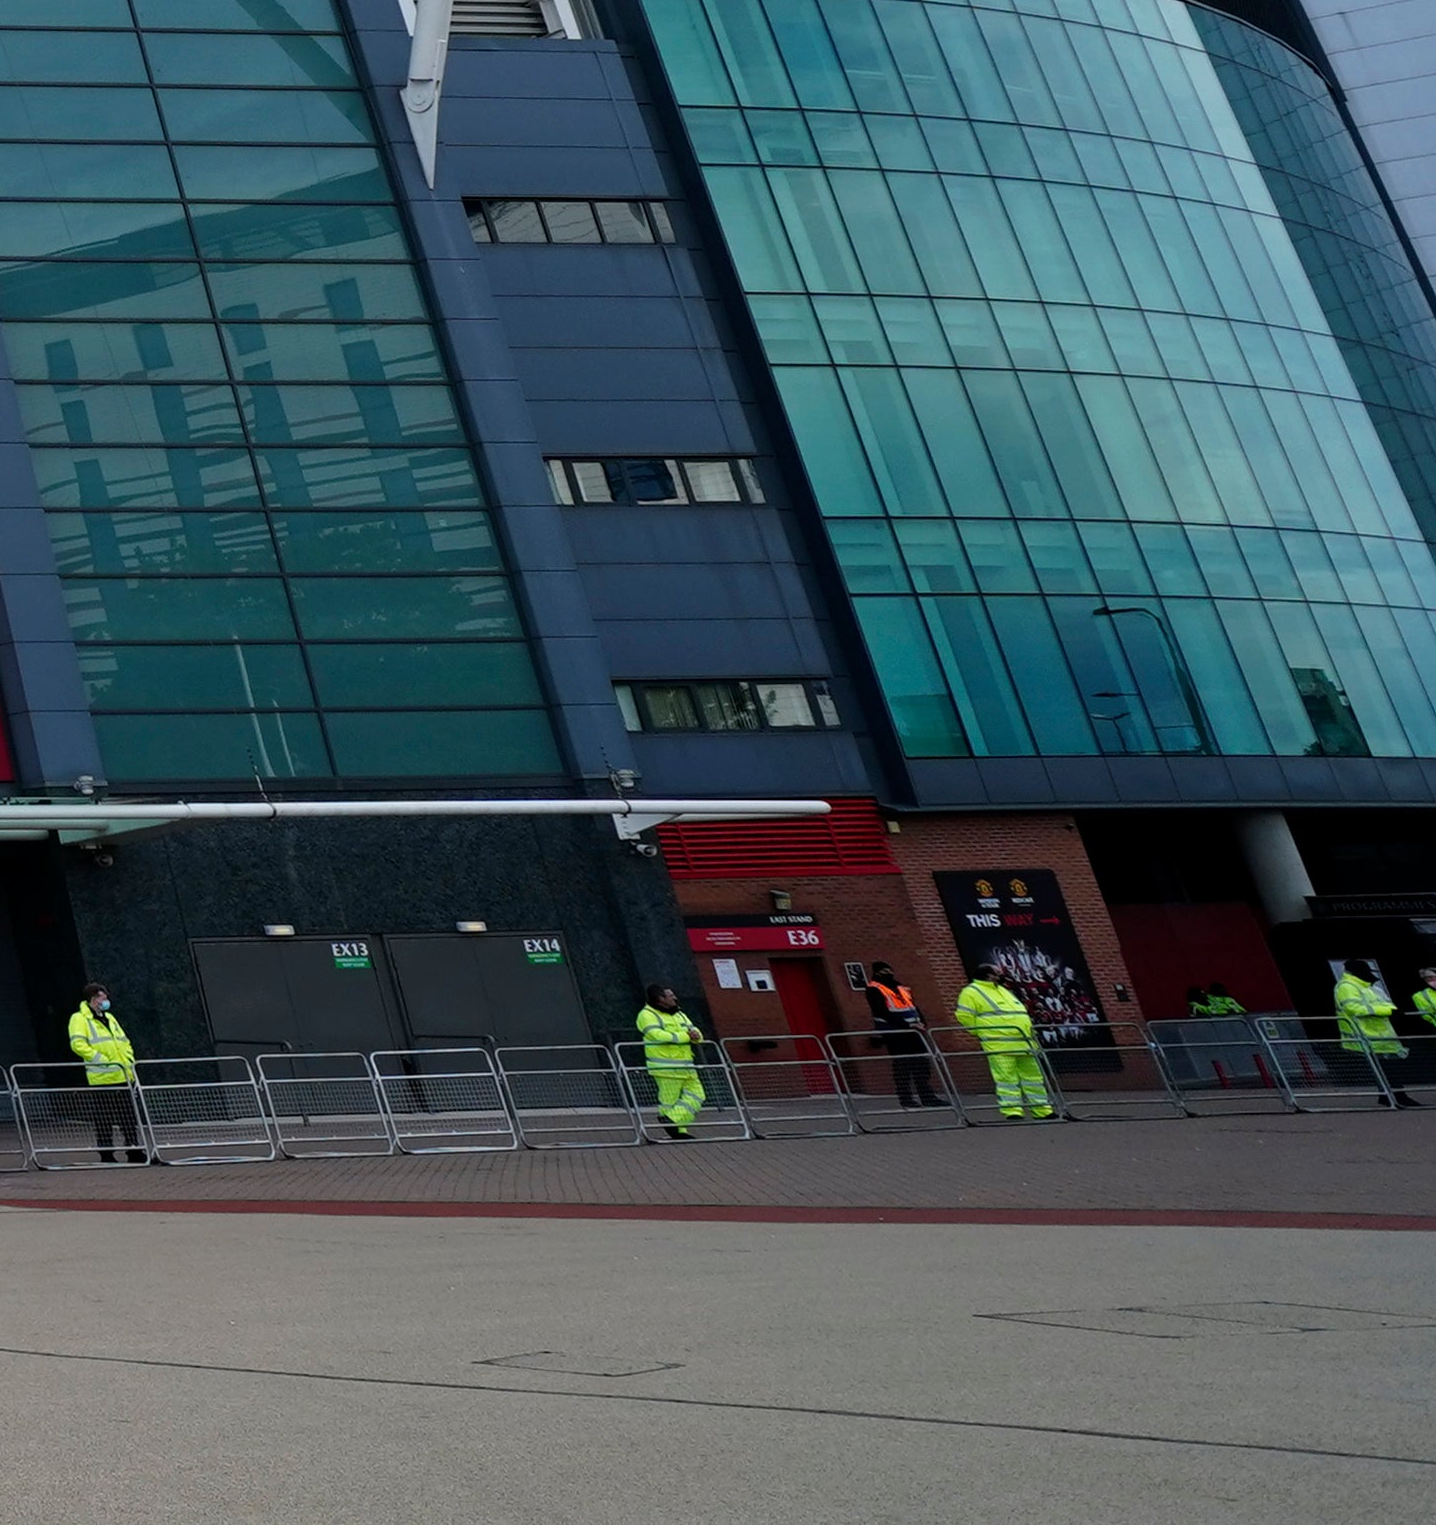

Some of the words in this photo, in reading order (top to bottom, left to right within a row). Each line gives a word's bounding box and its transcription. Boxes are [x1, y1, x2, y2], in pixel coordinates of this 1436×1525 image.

[769, 915, 787, 924] EAST
[787, 915, 813, 924] STAND
[965, 914, 1001, 928] THIS
[787, 930, 820, 945] E36
[331, 942, 369, 956] EX13
[523, 938, 561, 952] EX14
